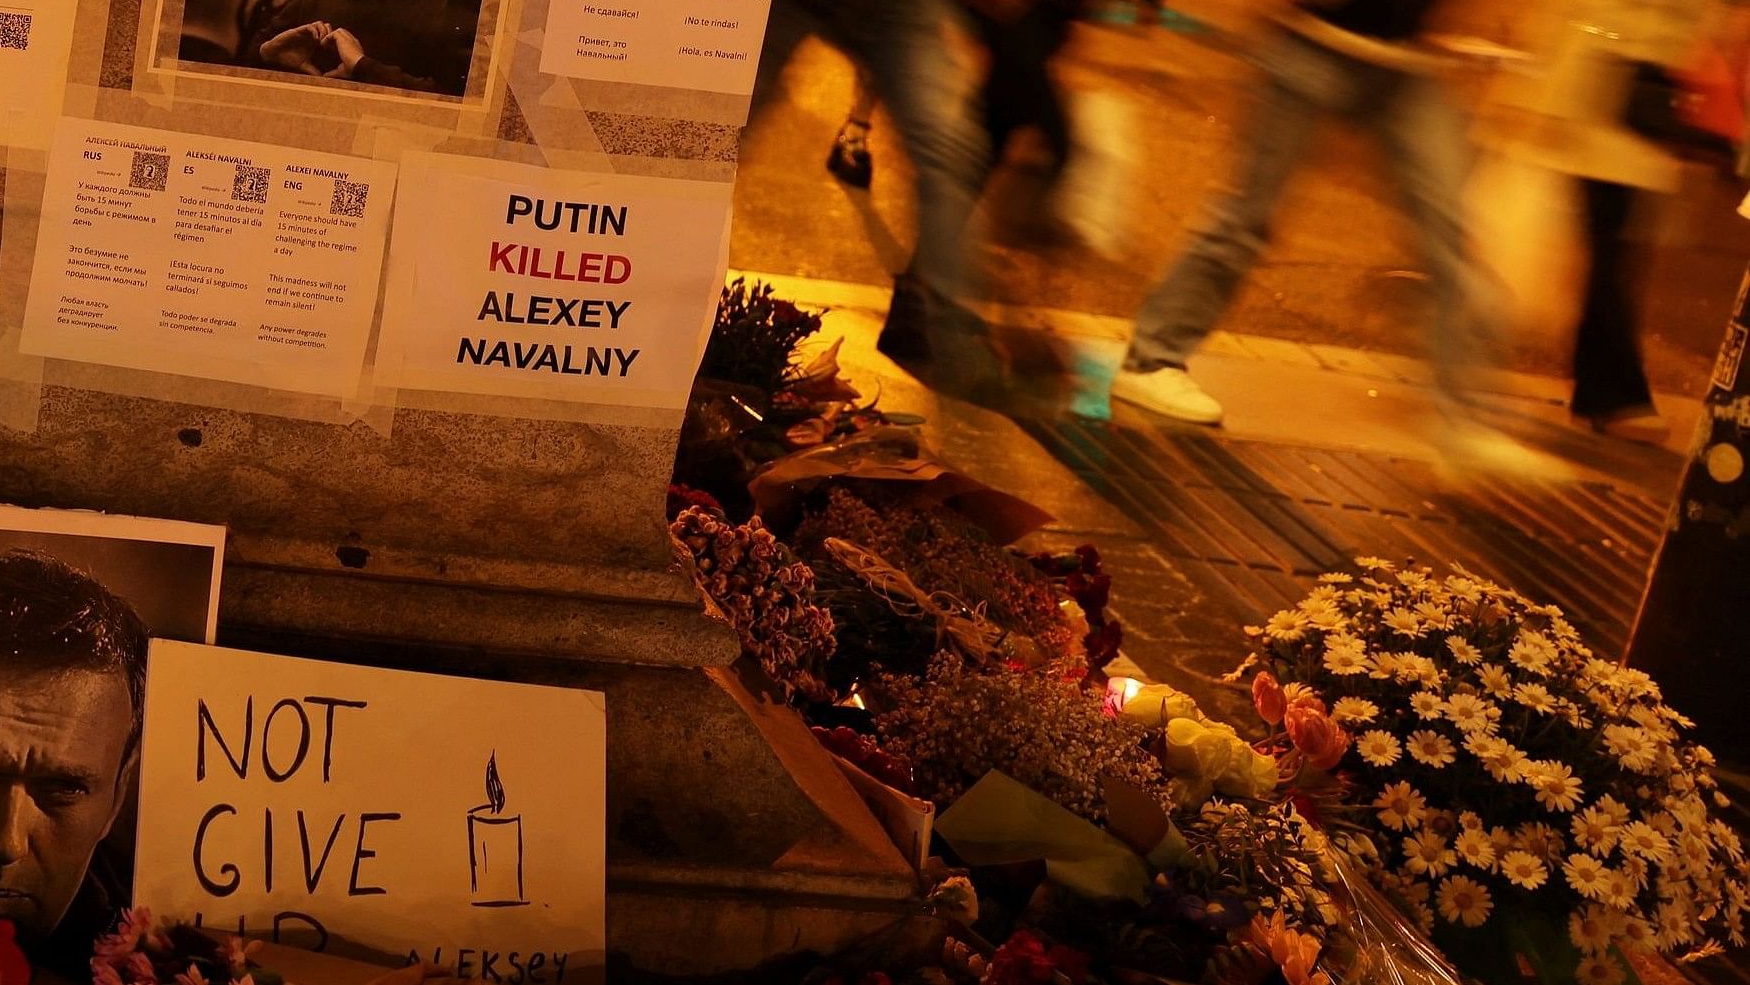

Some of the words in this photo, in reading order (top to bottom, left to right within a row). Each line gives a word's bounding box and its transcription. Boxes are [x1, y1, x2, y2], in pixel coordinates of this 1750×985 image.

[584, 5, 596, 14] Не
[597, 8, 639, 19] сдавайся!
[711, 19, 739, 29] rindas!
[576, 48, 628, 61] Навальный!
[578, 35, 611, 48] Привет,
[613, 41, 627, 49] это
[704, 50, 713, 59] es
[714, 50, 747, 60] Navalni!
[506, 194, 628, 236] PUTIN
[489, 242, 632, 284] KILLED
[478, 291, 632, 328] ALEXEY
[456, 338, 640, 376] NAVALNY
[196, 696, 367, 783] NOT
[193, 803, 401, 896] GIVE
